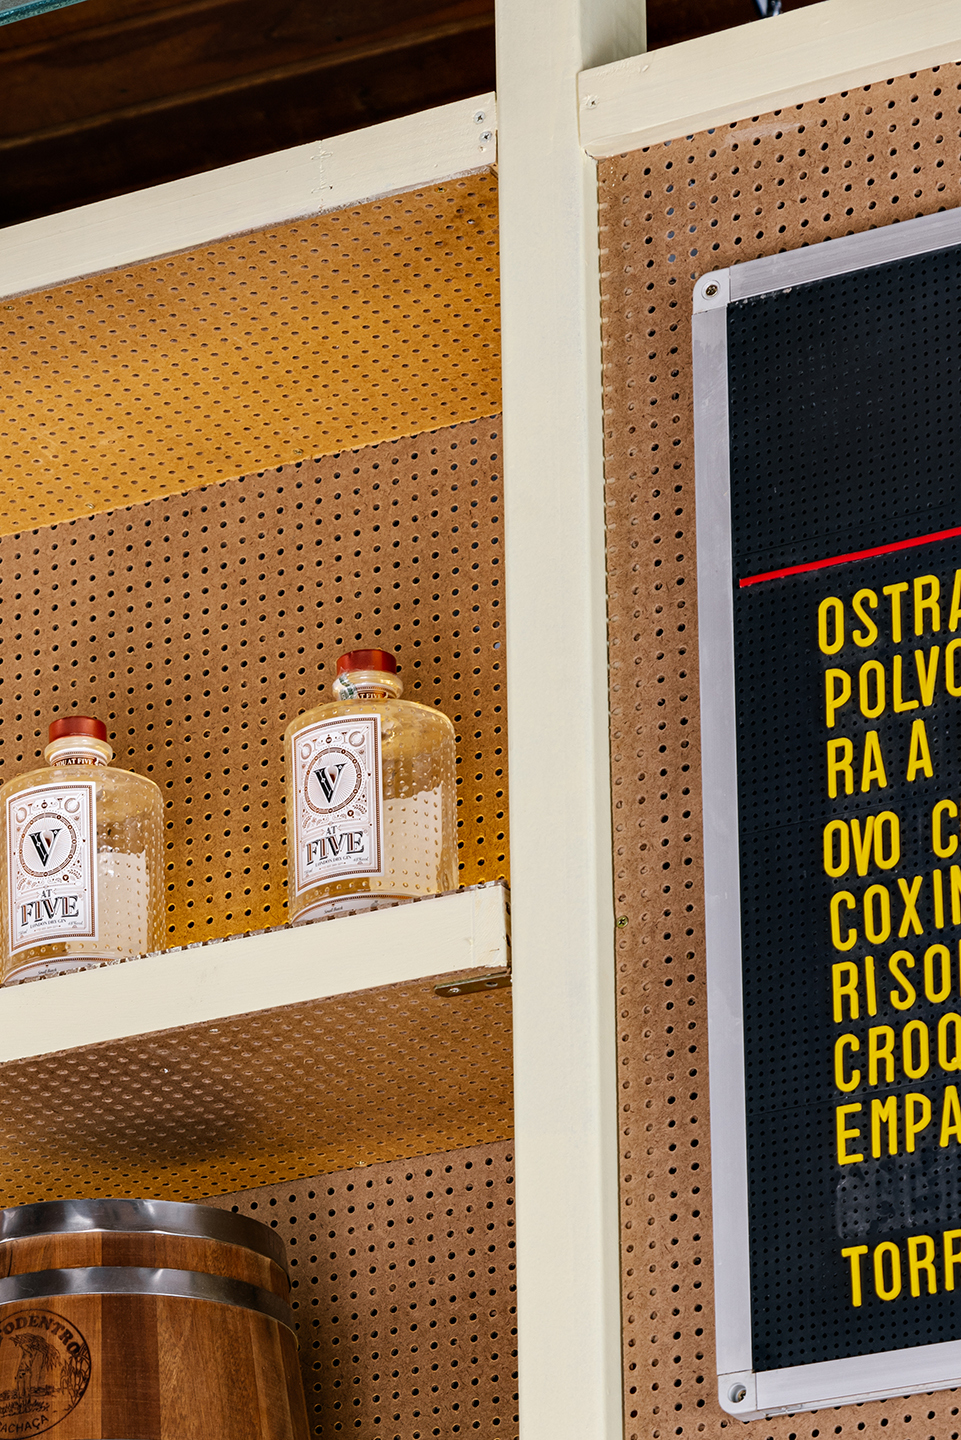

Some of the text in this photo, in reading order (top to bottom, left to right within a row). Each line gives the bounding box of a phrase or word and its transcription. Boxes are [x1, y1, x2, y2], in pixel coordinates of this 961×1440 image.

[825, 638, 961, 728] POLVO
[313, 763, 347, 804] V
[827, 718, 933, 798] RA A
[29, 828, 61, 867] V
[305, 831, 365, 866] FIVE
[325, 826, 338, 836] AT
[823, 799, 958, 877] OVO C
[20, 895, 79, 927] FIVE
[40, 889, 52, 898] AT
[832, 939, 961, 1023] RISO
[835, 1012, 961, 1092] CROQ
[836, 1085, 961, 1165] EMPA
